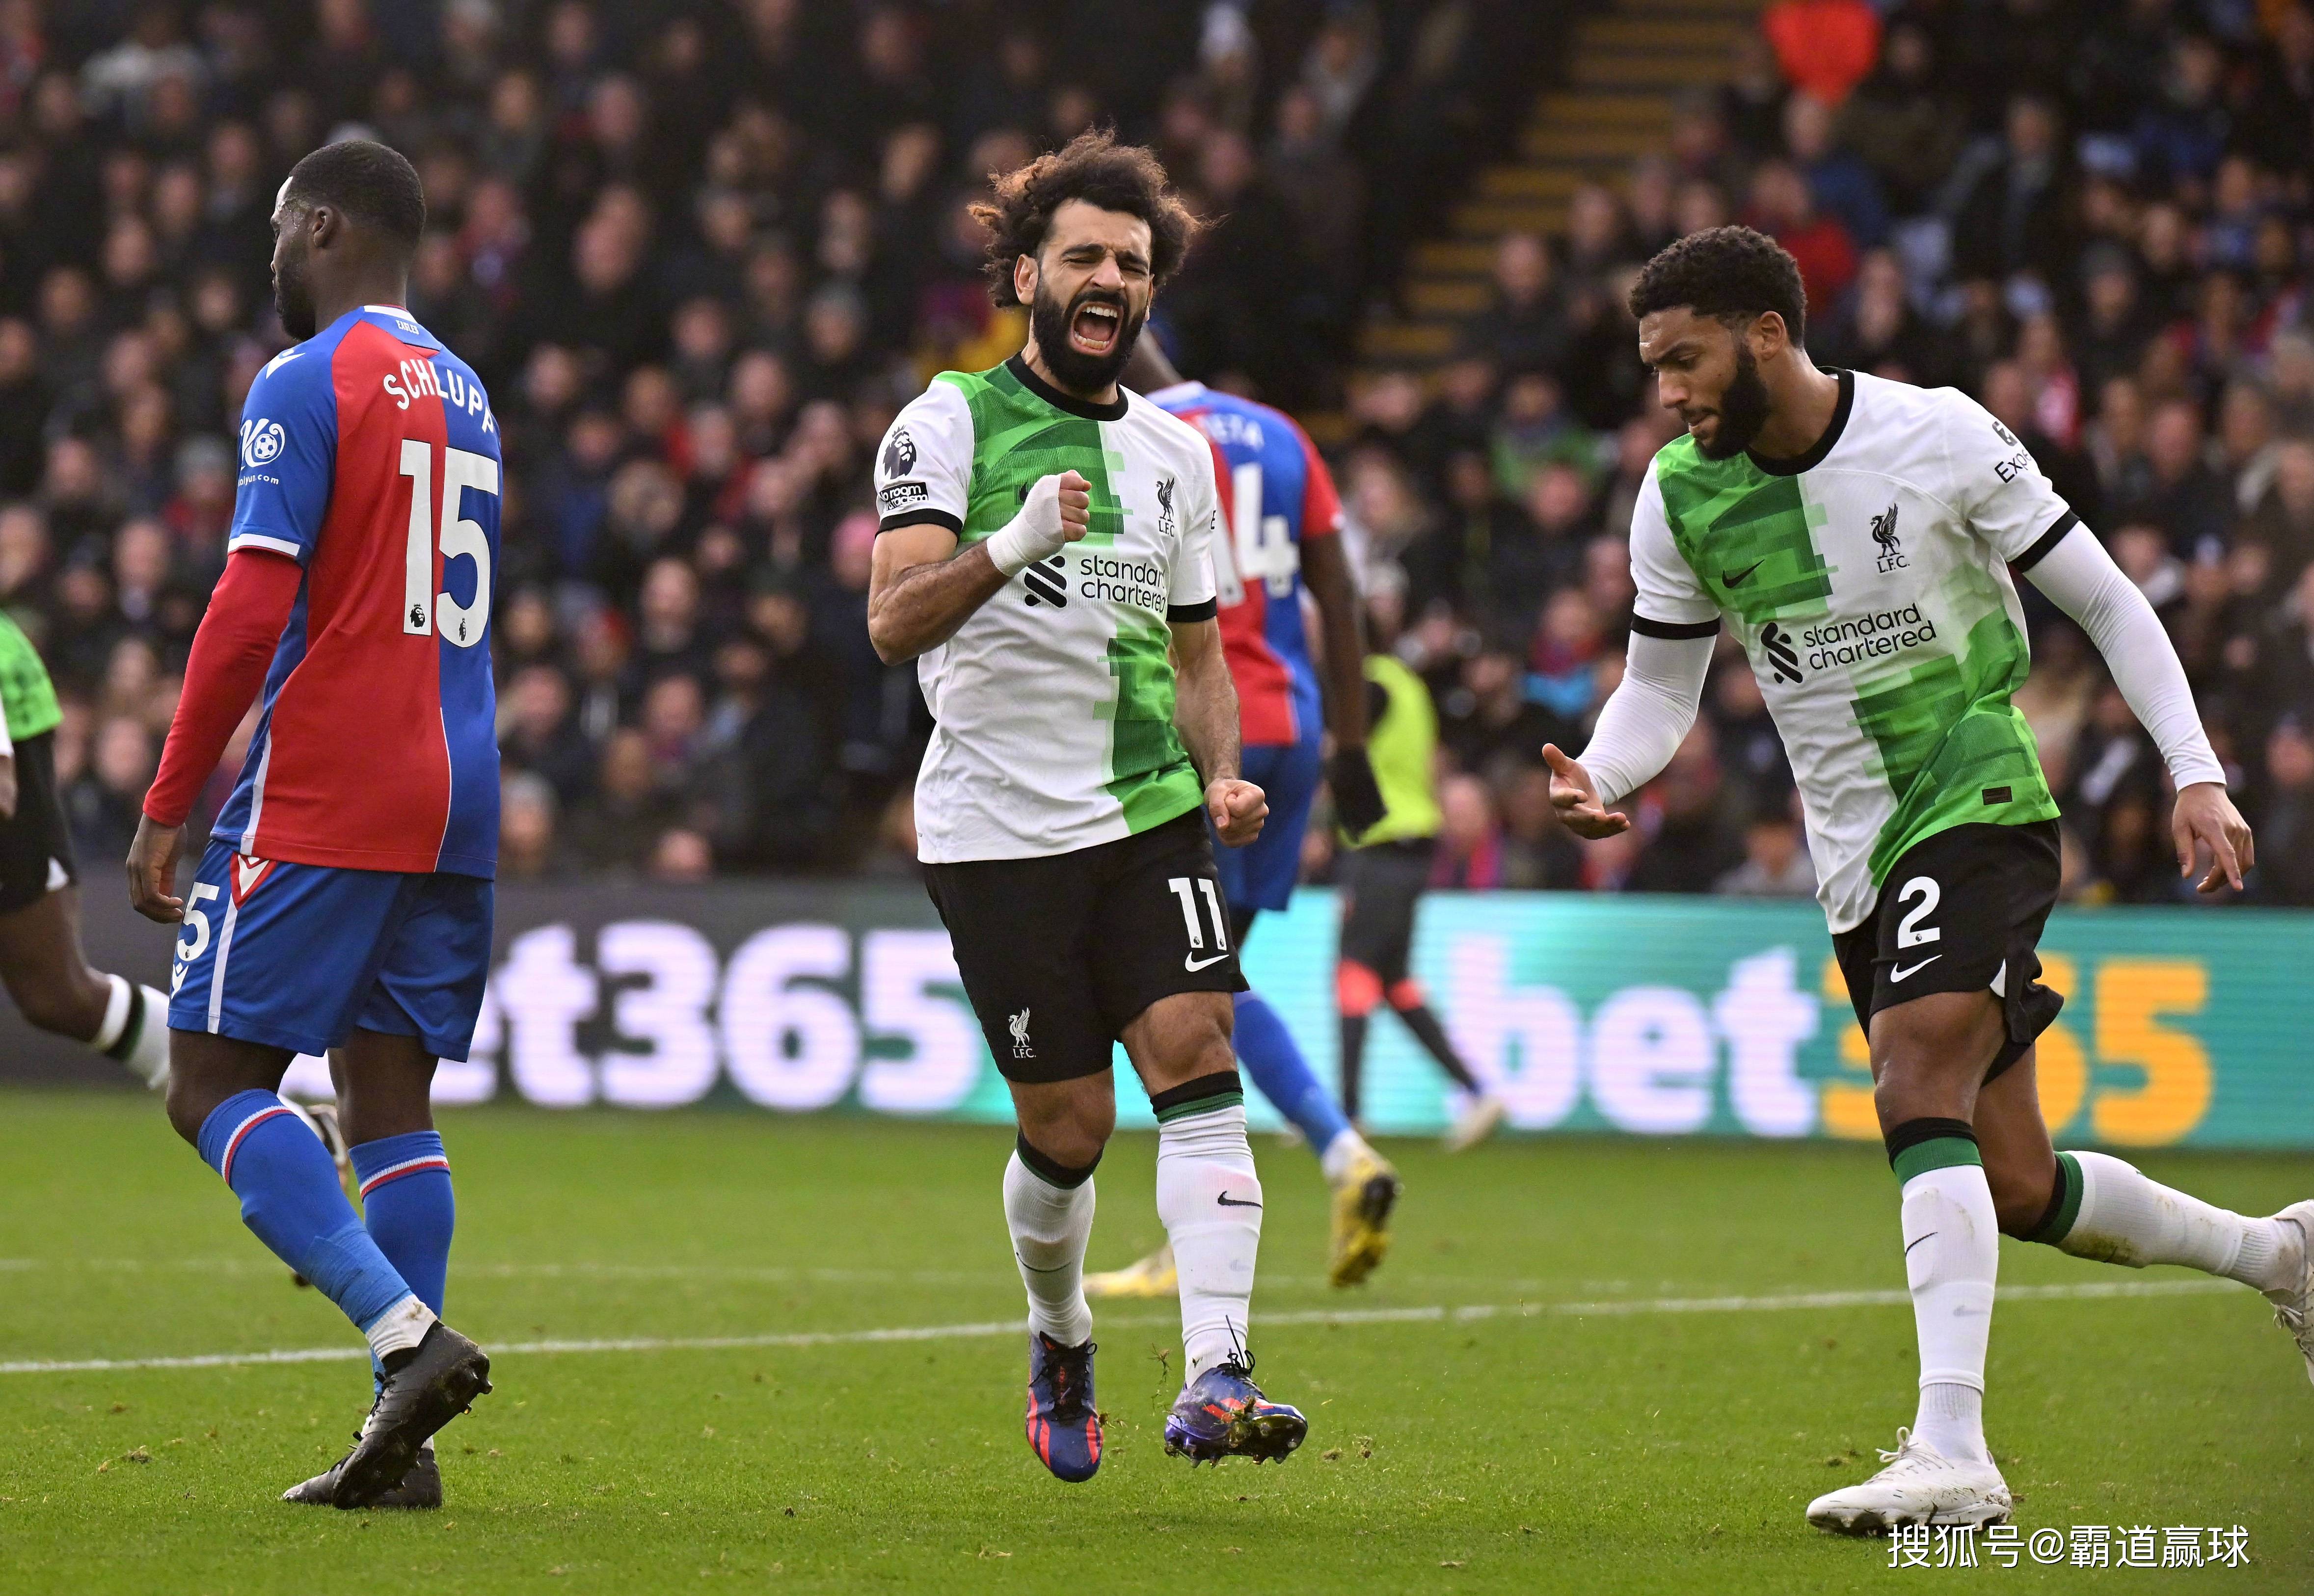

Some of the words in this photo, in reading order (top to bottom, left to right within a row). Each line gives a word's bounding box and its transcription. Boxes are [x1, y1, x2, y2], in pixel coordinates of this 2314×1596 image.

[396, 319, 419, 335] EAGLES
[889, 485, 921, 499] room
[400, 439, 499, 648] 15
[1803, 602, 1922, 647] standard
[1809, 619, 1937, 670] chartered
[1168, 877, 1227, 951] 11
[1898, 876, 1940, 949] 2
